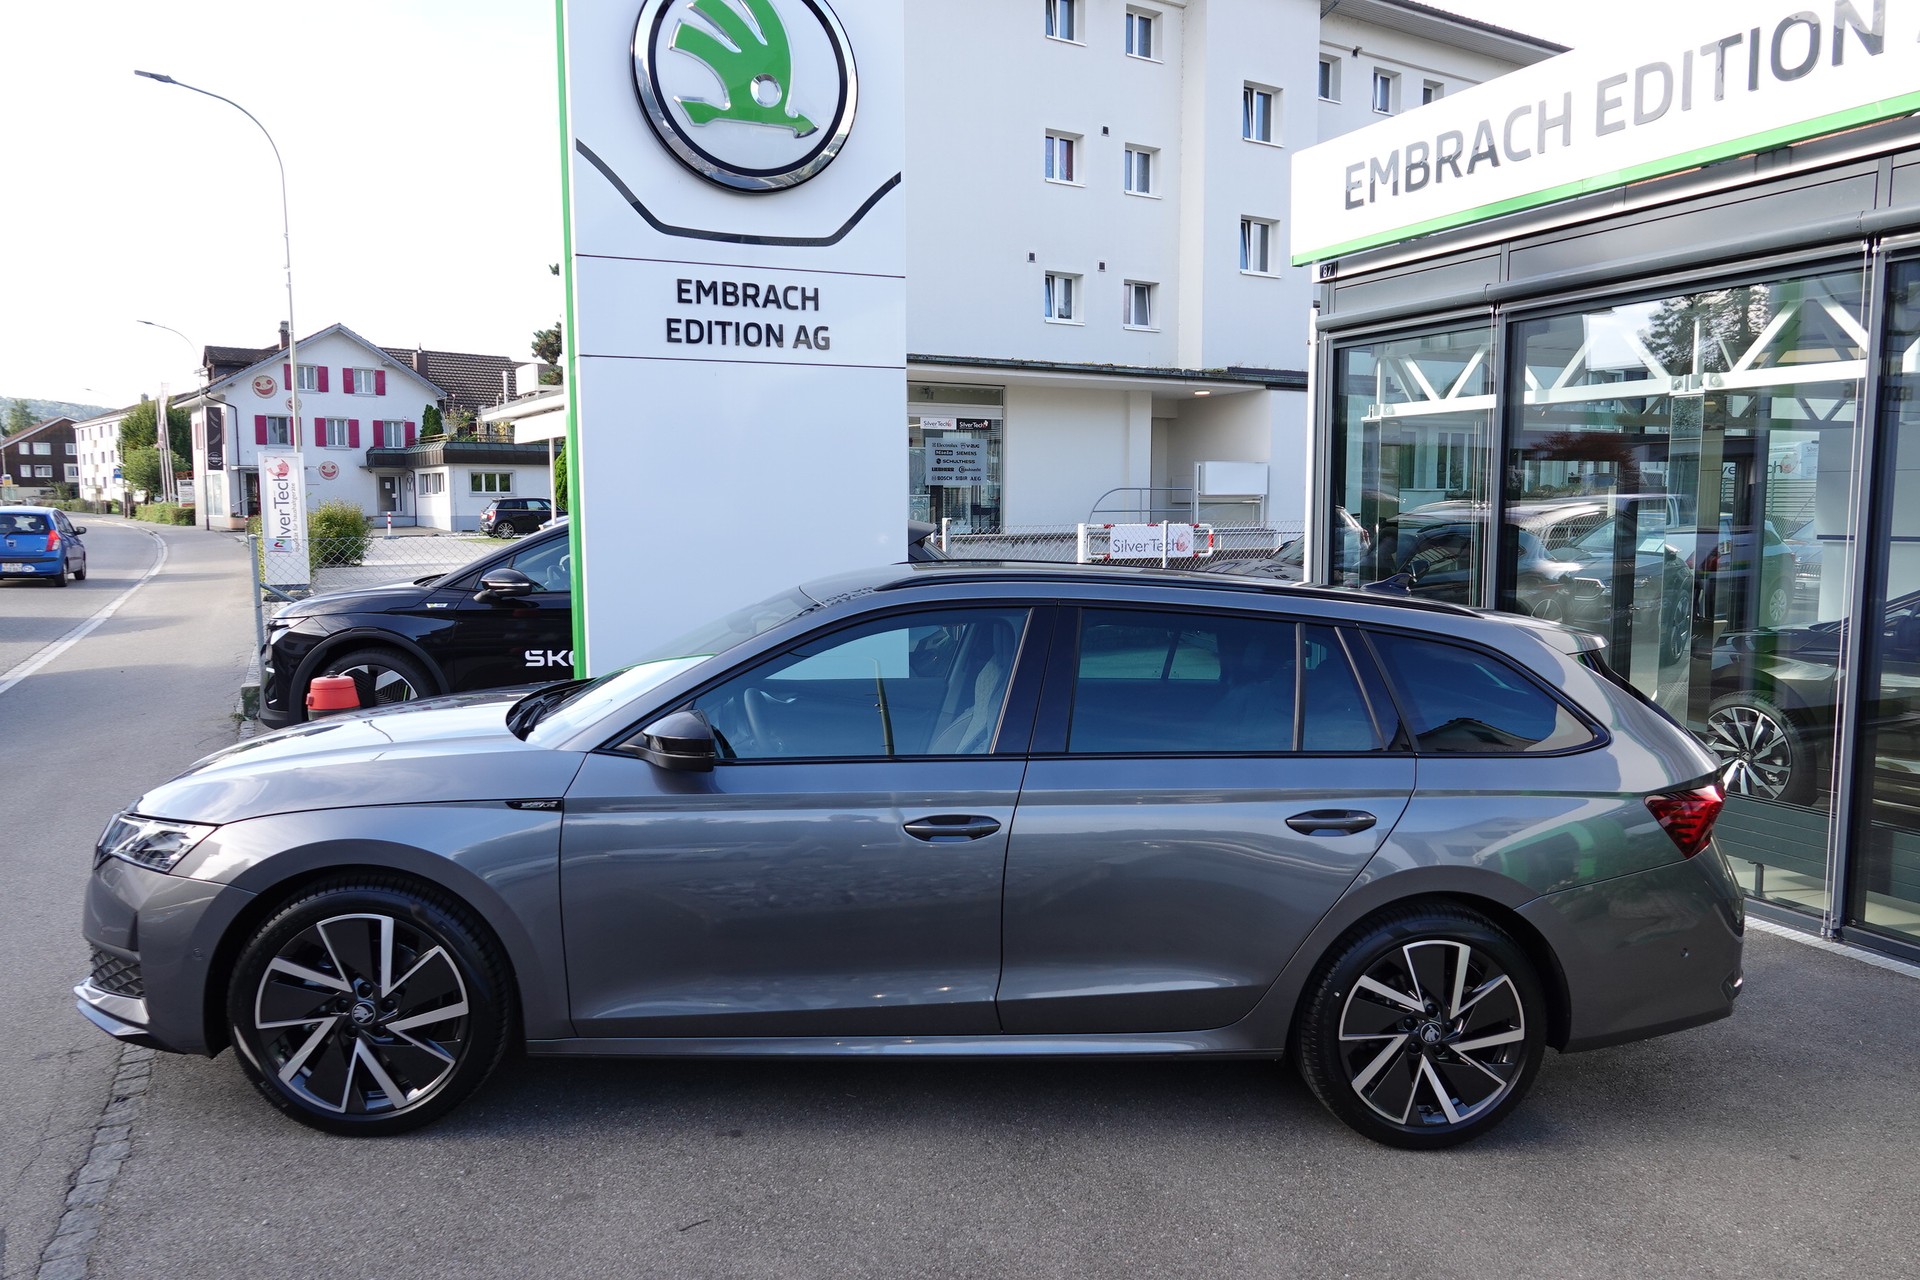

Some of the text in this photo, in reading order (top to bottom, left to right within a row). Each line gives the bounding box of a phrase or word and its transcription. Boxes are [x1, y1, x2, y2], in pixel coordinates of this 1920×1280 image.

[1345, 0, 1886, 211] EMBRACH EDITION
[1322, 264, 1332, 278] 87
[676, 278, 820, 311] EMBRACH
[666, 317, 831, 350] EDITION AG
